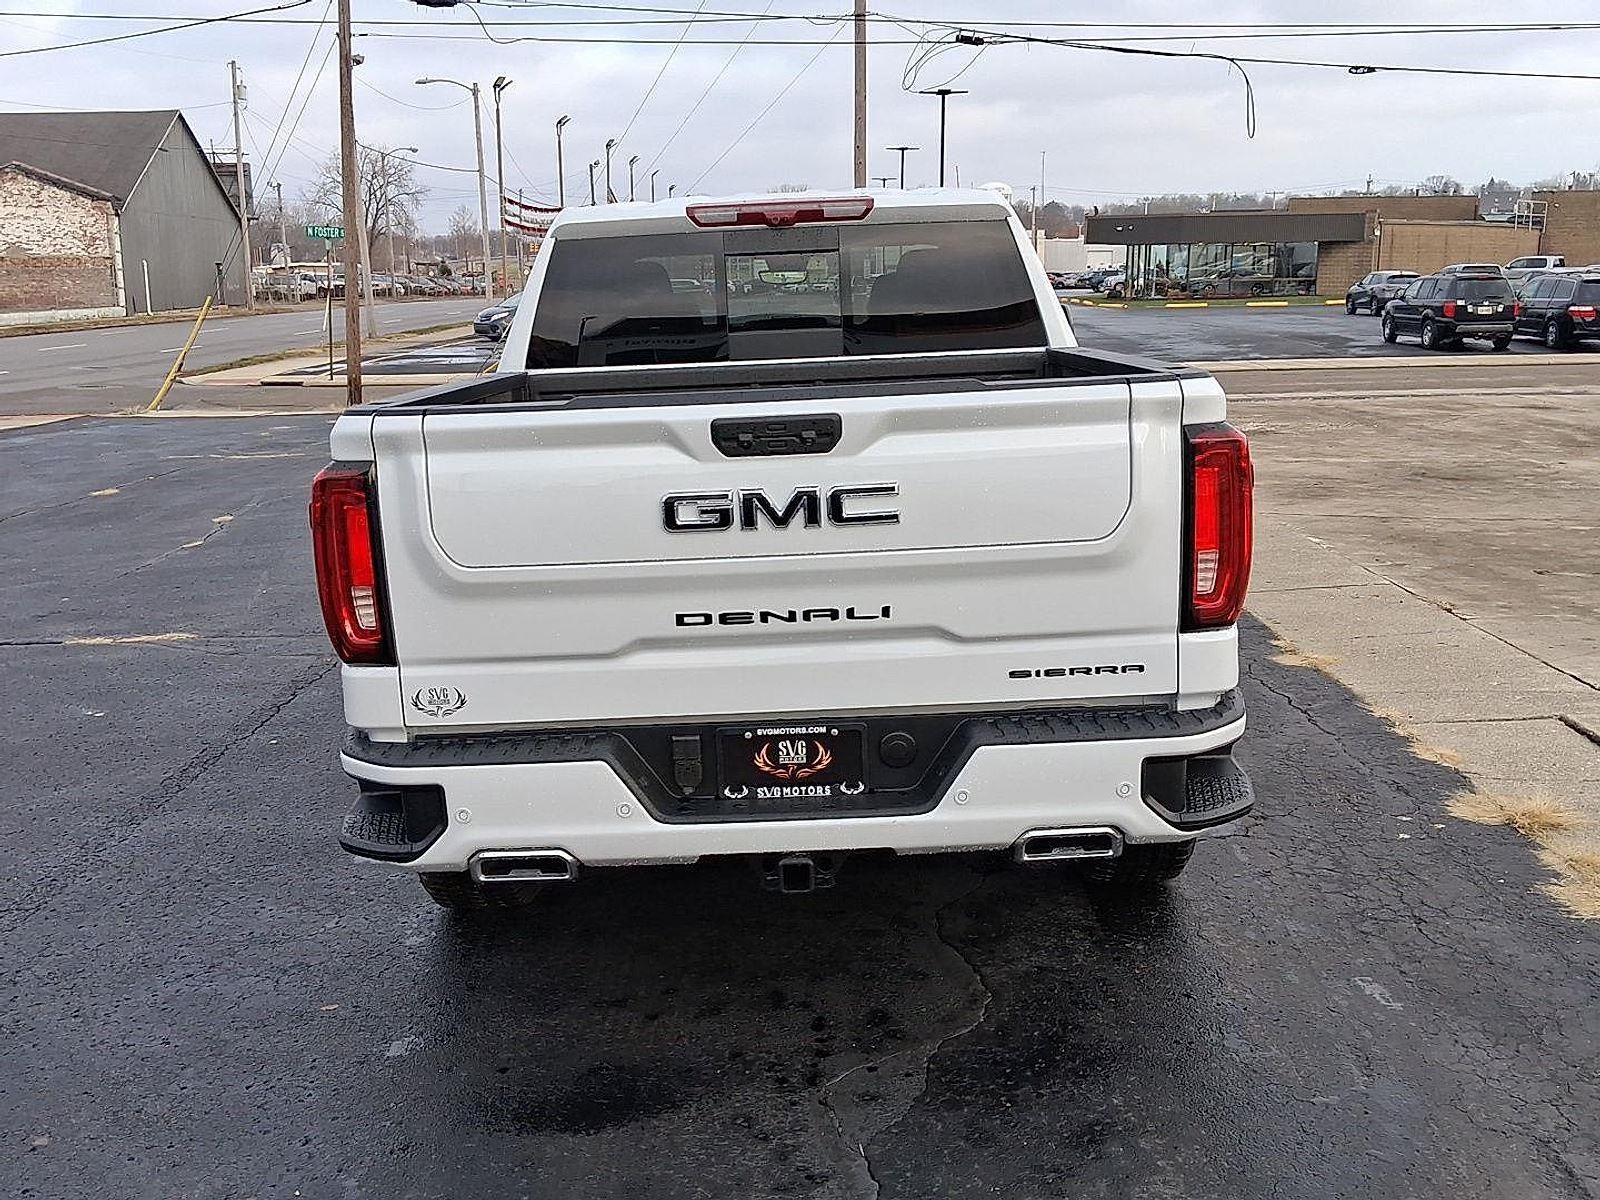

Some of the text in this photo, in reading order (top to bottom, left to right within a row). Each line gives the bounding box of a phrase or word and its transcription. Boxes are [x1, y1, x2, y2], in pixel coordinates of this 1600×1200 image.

[308, 227, 314, 236] N
[314, 227, 339, 238] FOSTER
[662, 481, 900, 533] GMC
[675, 605, 891, 627] DENALI
[1008, 664, 1145, 679] SIERRA
[427, 687, 448, 700] SVG
[756, 726, 826, 736] SVGMOTORS.COM
[778, 739, 807, 757] SVG
[756, 785, 832, 798] SVG MOTORS
